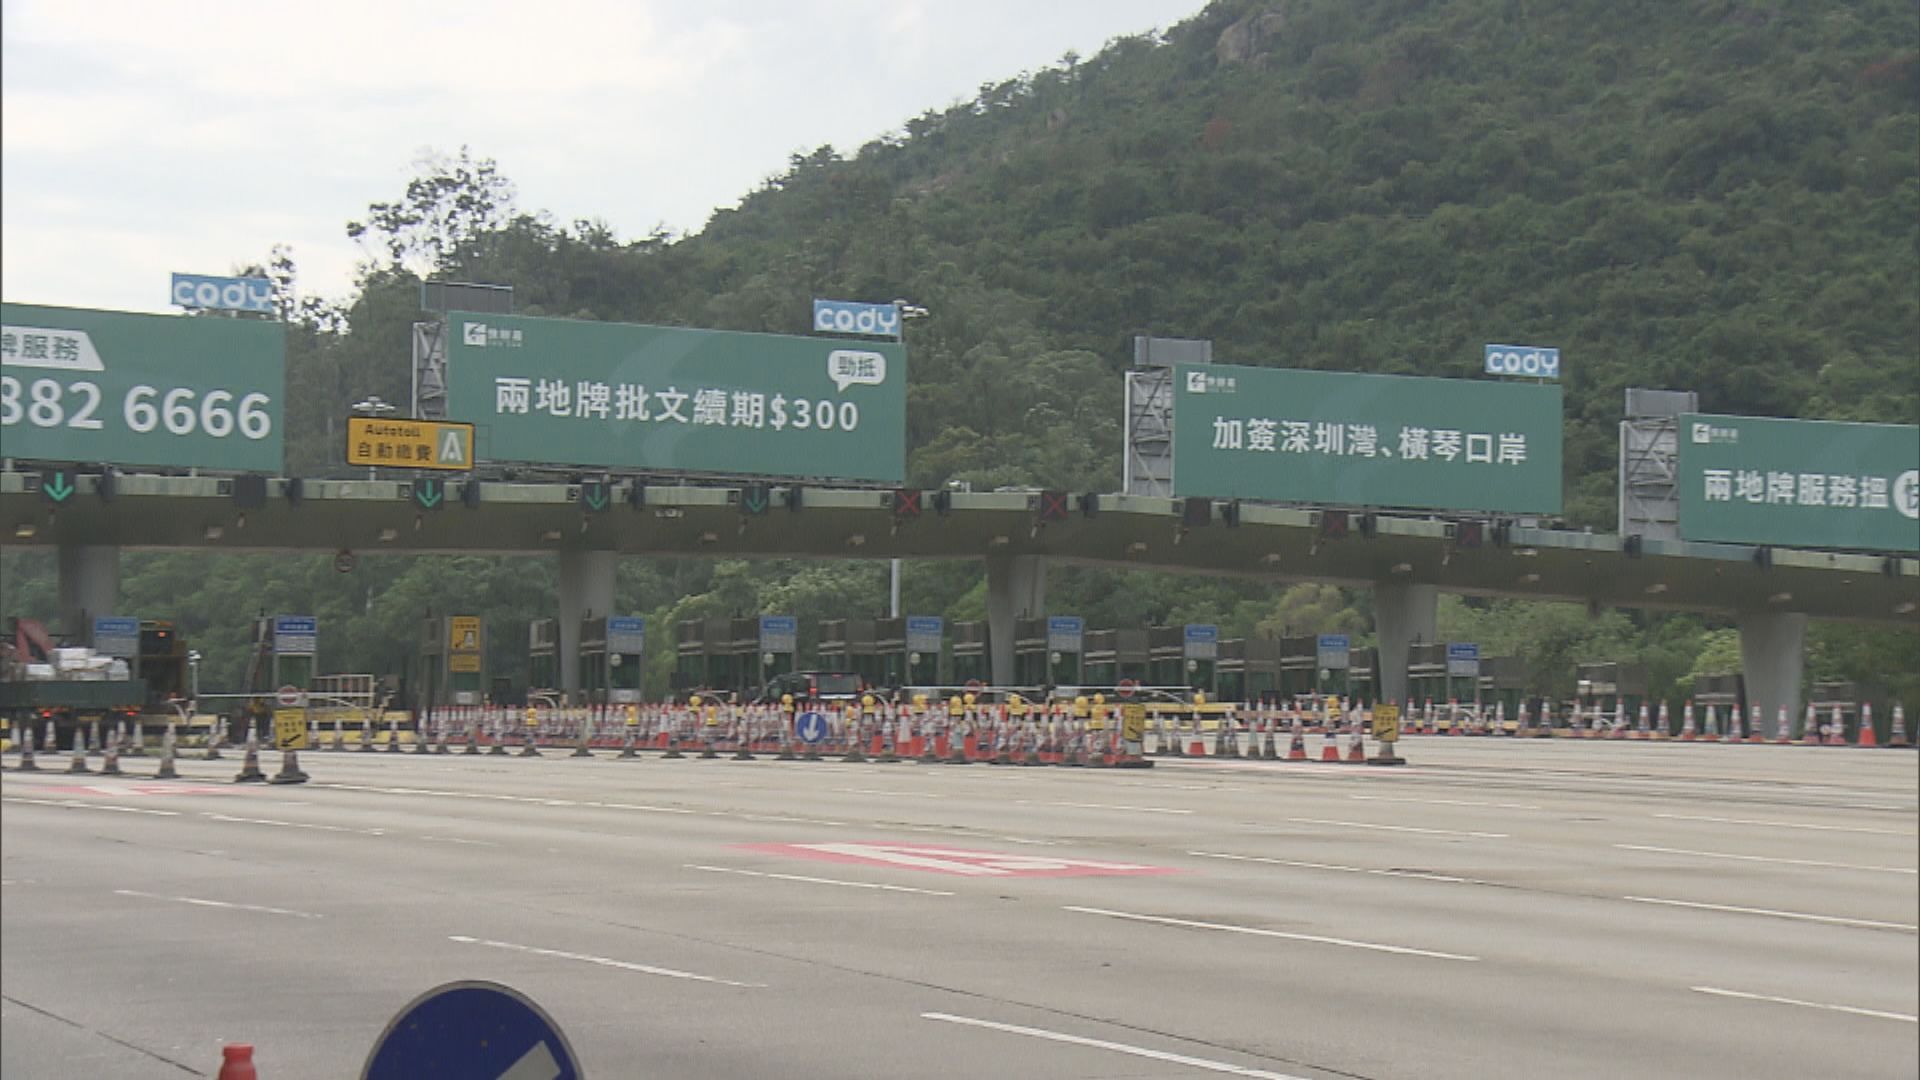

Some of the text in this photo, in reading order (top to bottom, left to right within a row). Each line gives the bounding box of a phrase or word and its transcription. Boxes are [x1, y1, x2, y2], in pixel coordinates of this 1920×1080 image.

[175, 281, 272, 310] cody
[816, 308, 897, 334] cody
[837, 356, 876, 377] 勁抵
[1488, 352, 1558, 375] cody
[124, 385, 271, 440] 6666
[495, 378, 858, 431] 兩地牌批文續期$300
